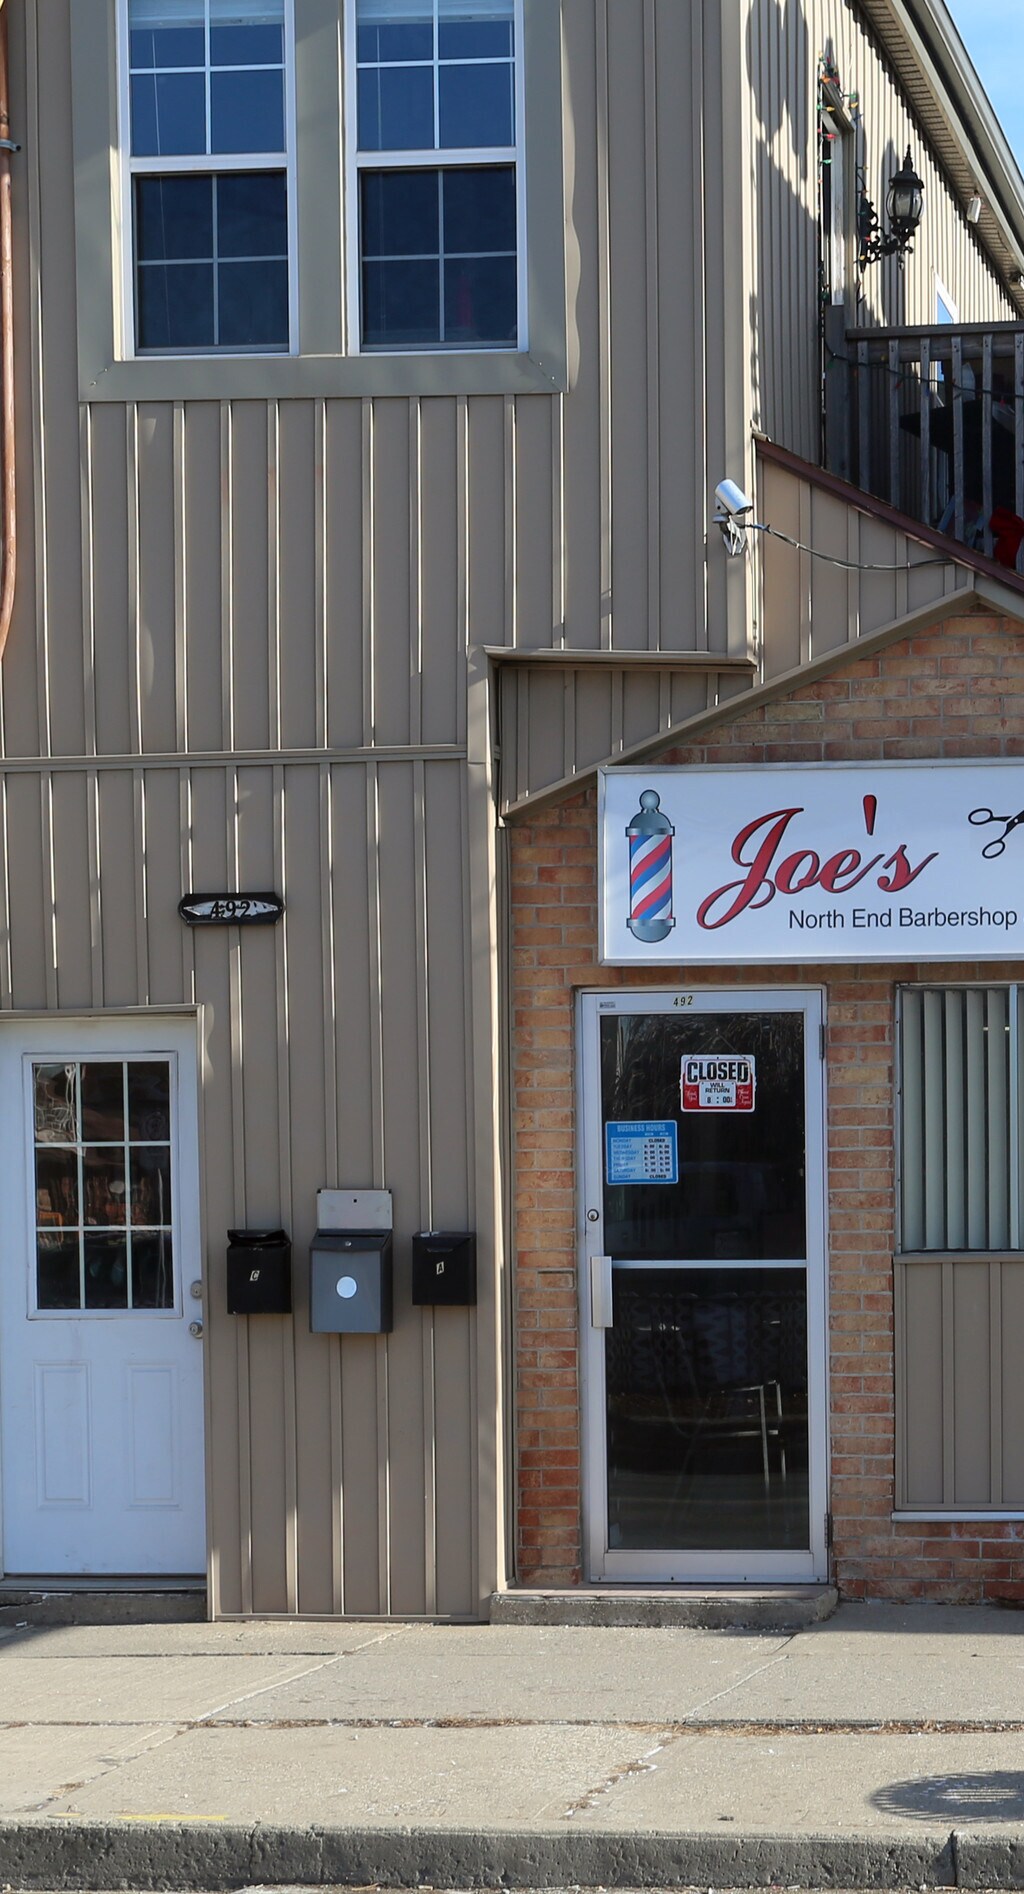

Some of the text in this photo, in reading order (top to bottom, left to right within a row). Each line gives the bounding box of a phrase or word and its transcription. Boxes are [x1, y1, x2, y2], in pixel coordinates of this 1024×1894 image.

[696, 794, 939, 930] Joe's
[210, 900, 251, 919] 492
[788, 909, 845, 929] North
[852, 907, 893, 928] End
[899, 906, 1018, 930] Barbershop
[673, 995, 693, 1007] 492
[687, 1061, 749, 1083] CLOSED
